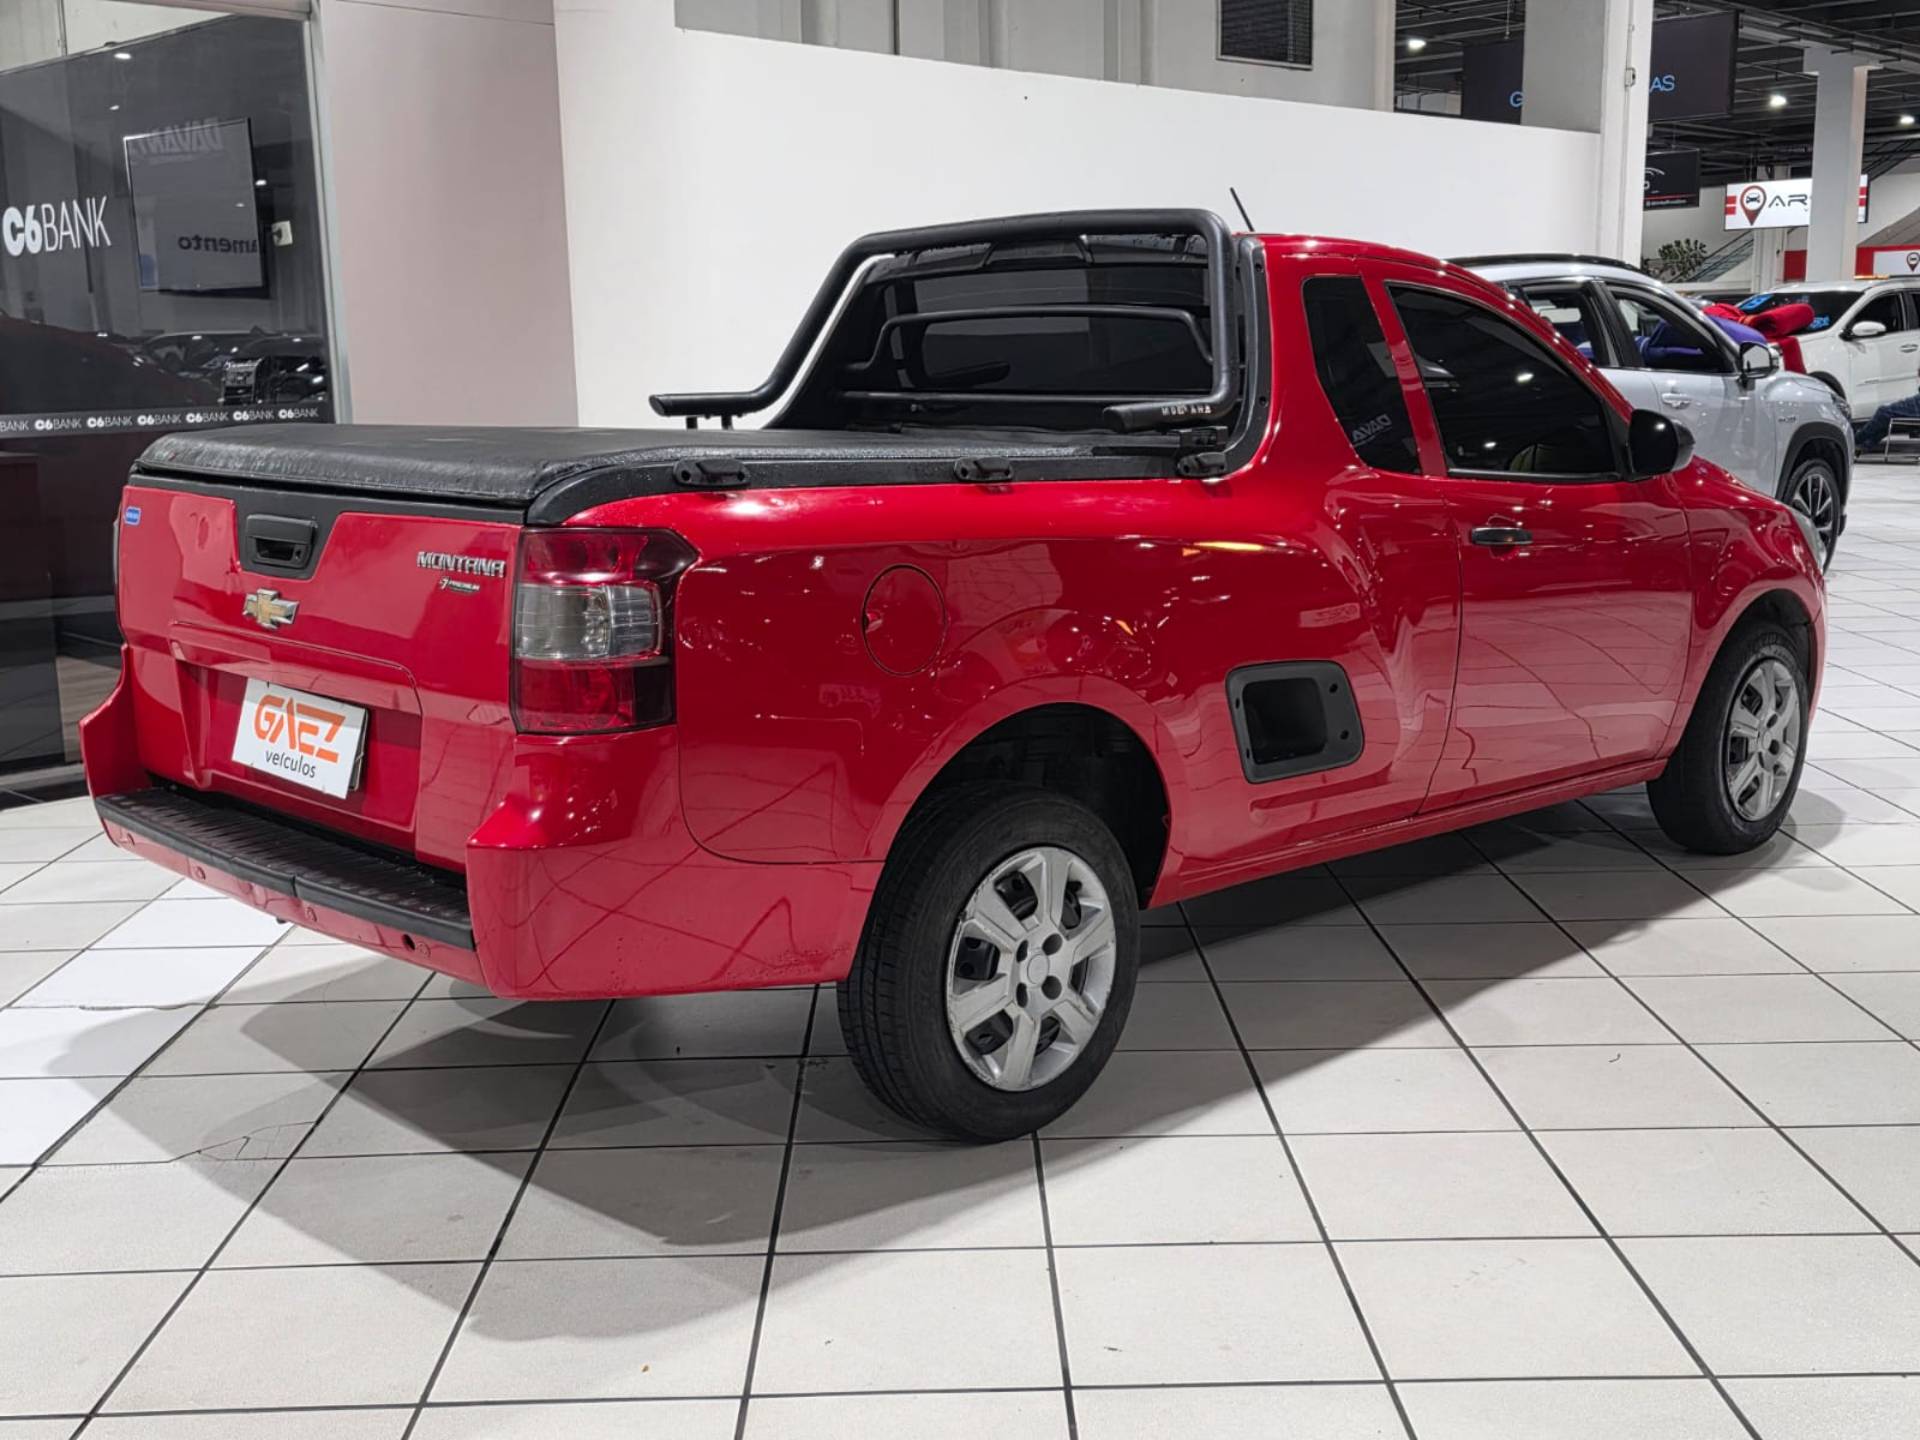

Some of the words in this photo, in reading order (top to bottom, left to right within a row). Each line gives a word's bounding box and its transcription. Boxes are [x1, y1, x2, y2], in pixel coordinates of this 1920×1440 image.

[1768, 194, 1811, 208] AR
[2, 195, 112, 257] C6BANK
[416, 551, 506, 578] MONTANA
[254, 694, 346, 764] GAEZ
[265, 750, 316, 778] veículos
